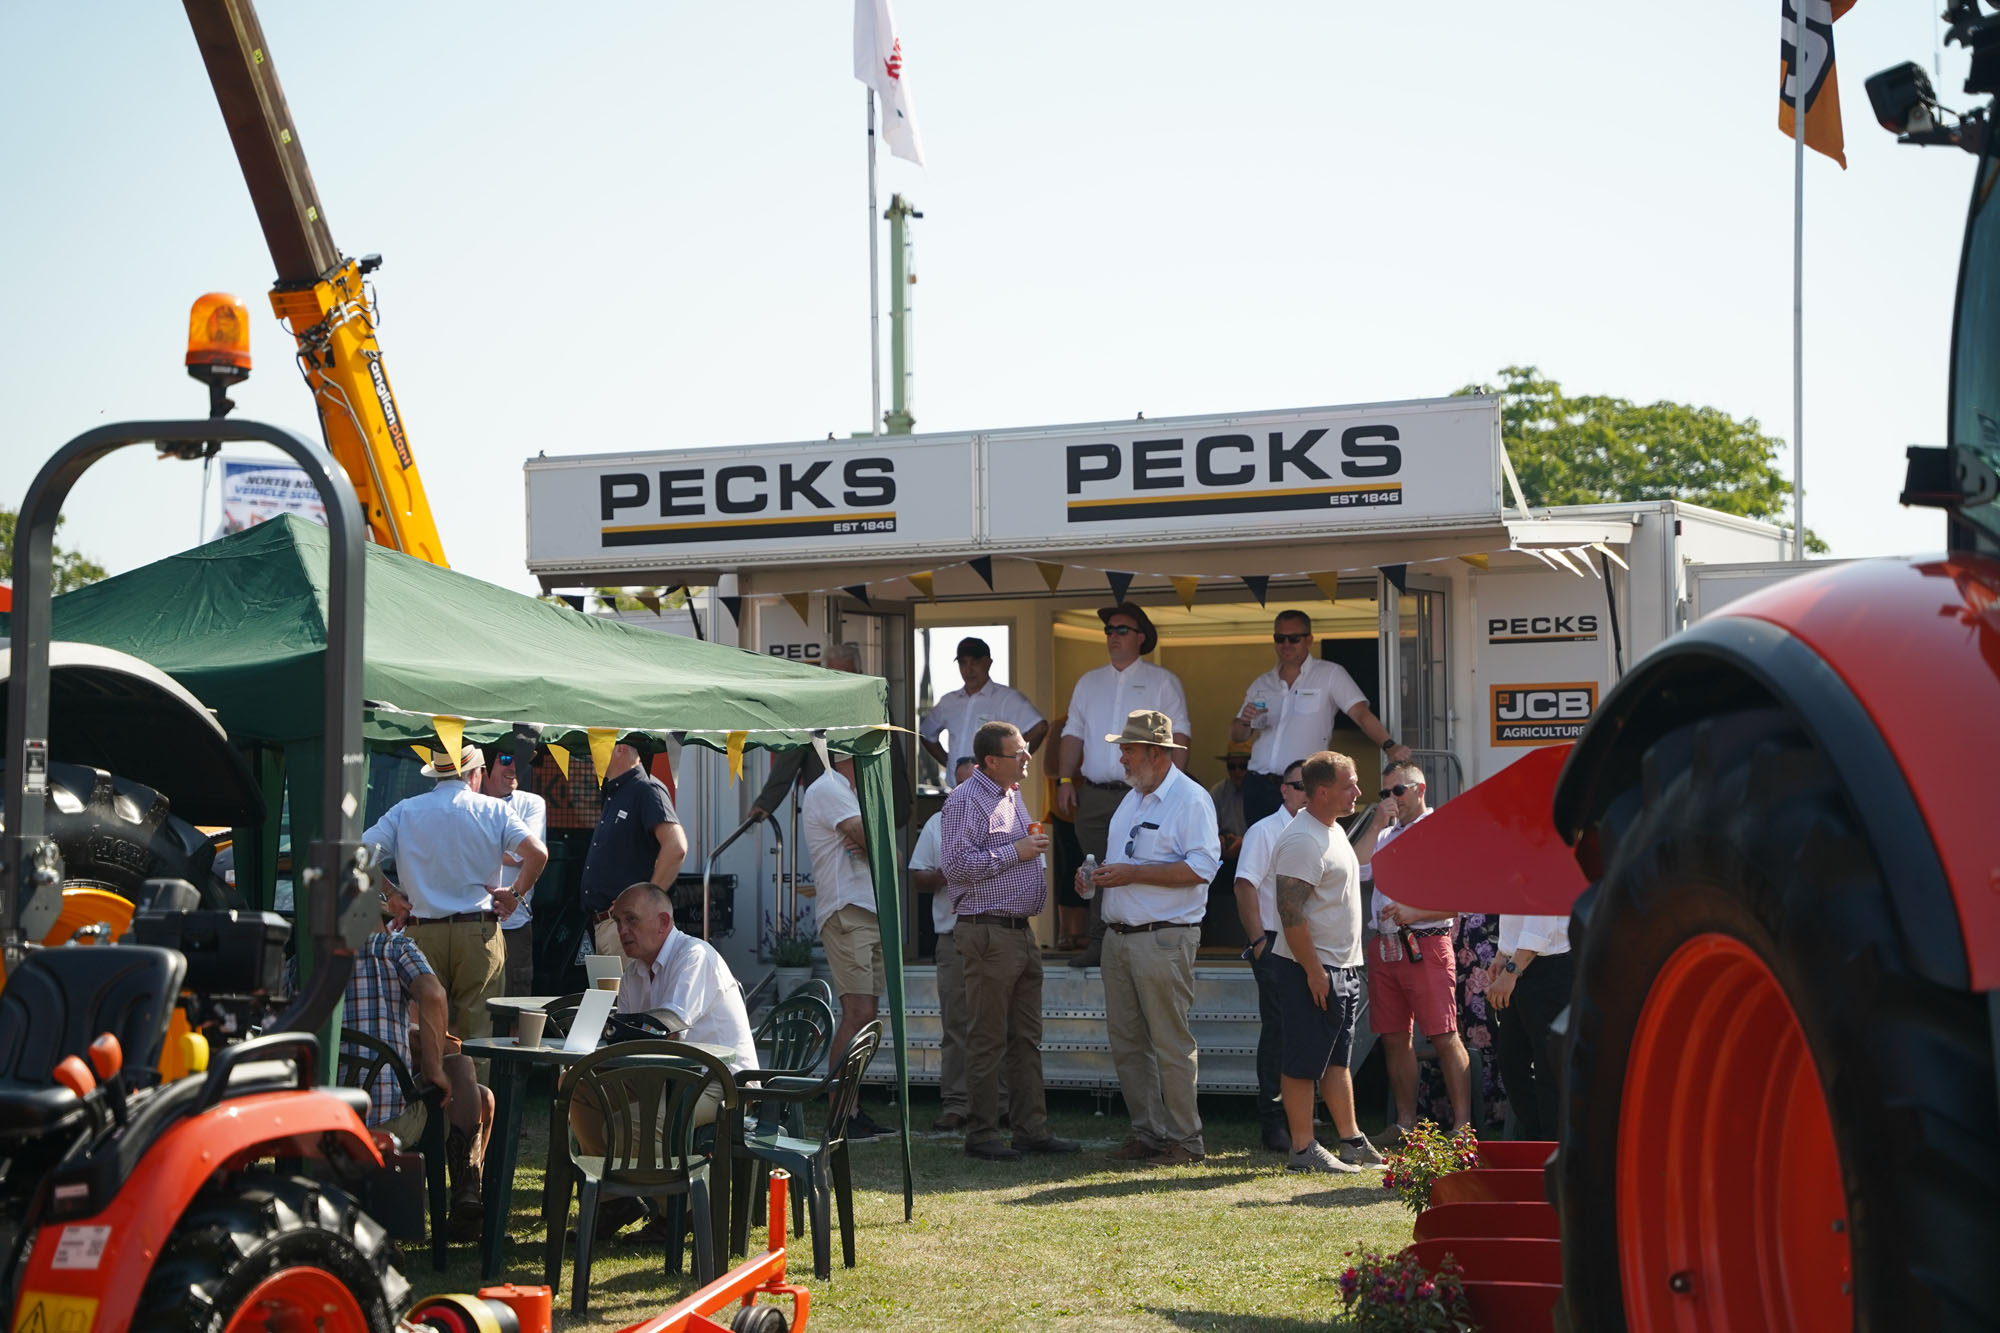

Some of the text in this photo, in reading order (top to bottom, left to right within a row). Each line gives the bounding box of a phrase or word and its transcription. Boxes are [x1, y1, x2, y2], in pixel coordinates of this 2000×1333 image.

[369, 361, 411, 466] anglianplant
[1066, 424, 1402, 494] PECKS
[245, 475, 291, 488] NORTH
[600, 457, 896, 520] PECKS
[234, 485, 287, 498] VEHICLE
[1329, 491, 1399, 505] EST 1846
[833, 520, 894, 532] EST 1846
[1489, 616, 1597, 635] PECKS
[768, 643, 822, 659] PEC
[1498, 691, 1590, 719] JCB
[772, 873, 815, 883] PECK
